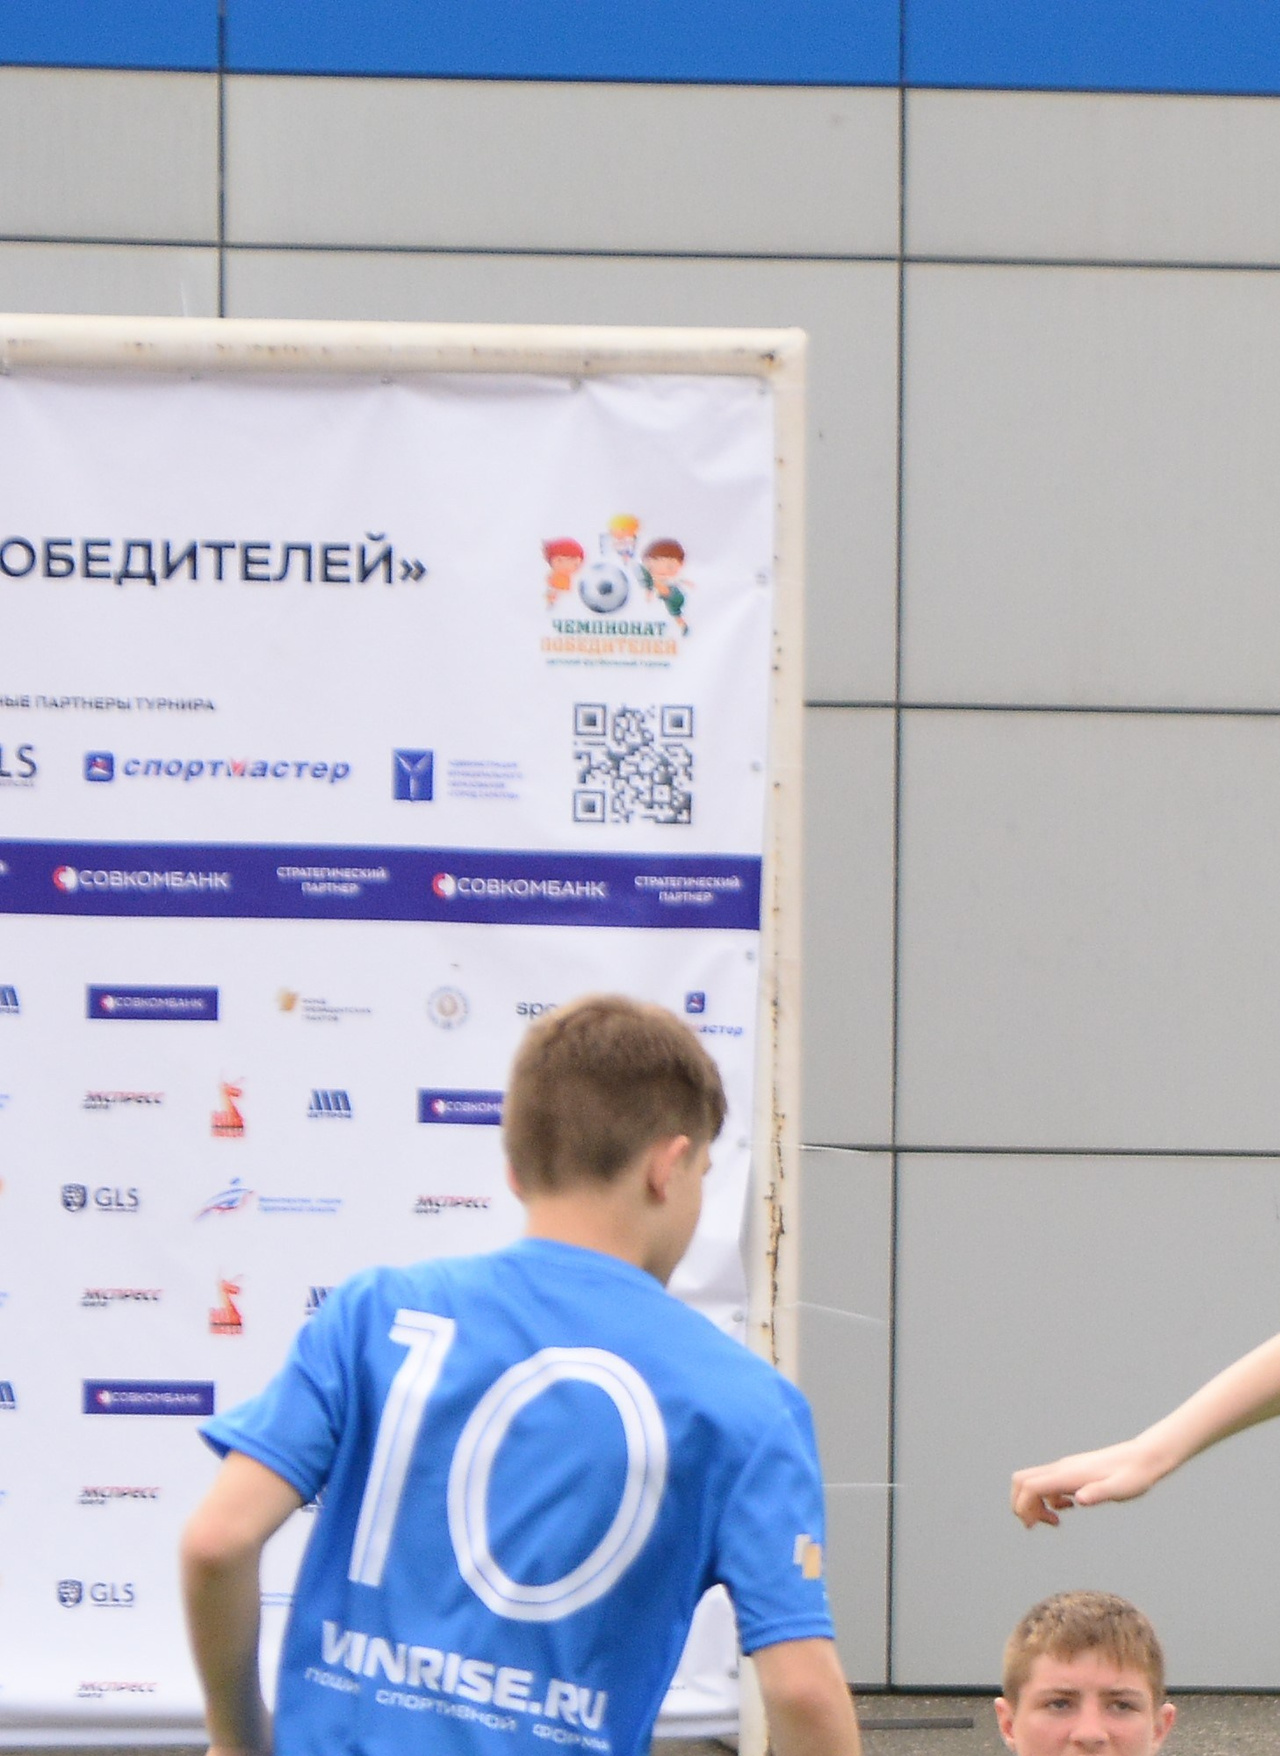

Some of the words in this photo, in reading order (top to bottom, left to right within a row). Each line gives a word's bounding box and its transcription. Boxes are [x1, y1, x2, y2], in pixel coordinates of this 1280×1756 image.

[0, 532, 427, 586] ОБЕДИТЕЛЕЙ»
[551, 619, 667, 636] ЧЕМПИОНАТ
[0, 695, 30, 708] ЫЕ
[35, 696, 131, 710] ПАРТНЕРЫ
[135, 697, 215, 711] ТУРНИРА
[122, 758, 351, 785] спортмастер
[80, 869, 232, 889] СОВКОМБАНК
[457, 876, 606, 898] СОВКОМБАНК
[659, 890, 714, 903] ПАРТНЕР
[94, 1187, 140, 1207] GLS
[349, 1307, 668, 1622] 10
[91, 1582, 135, 1602] GLS
